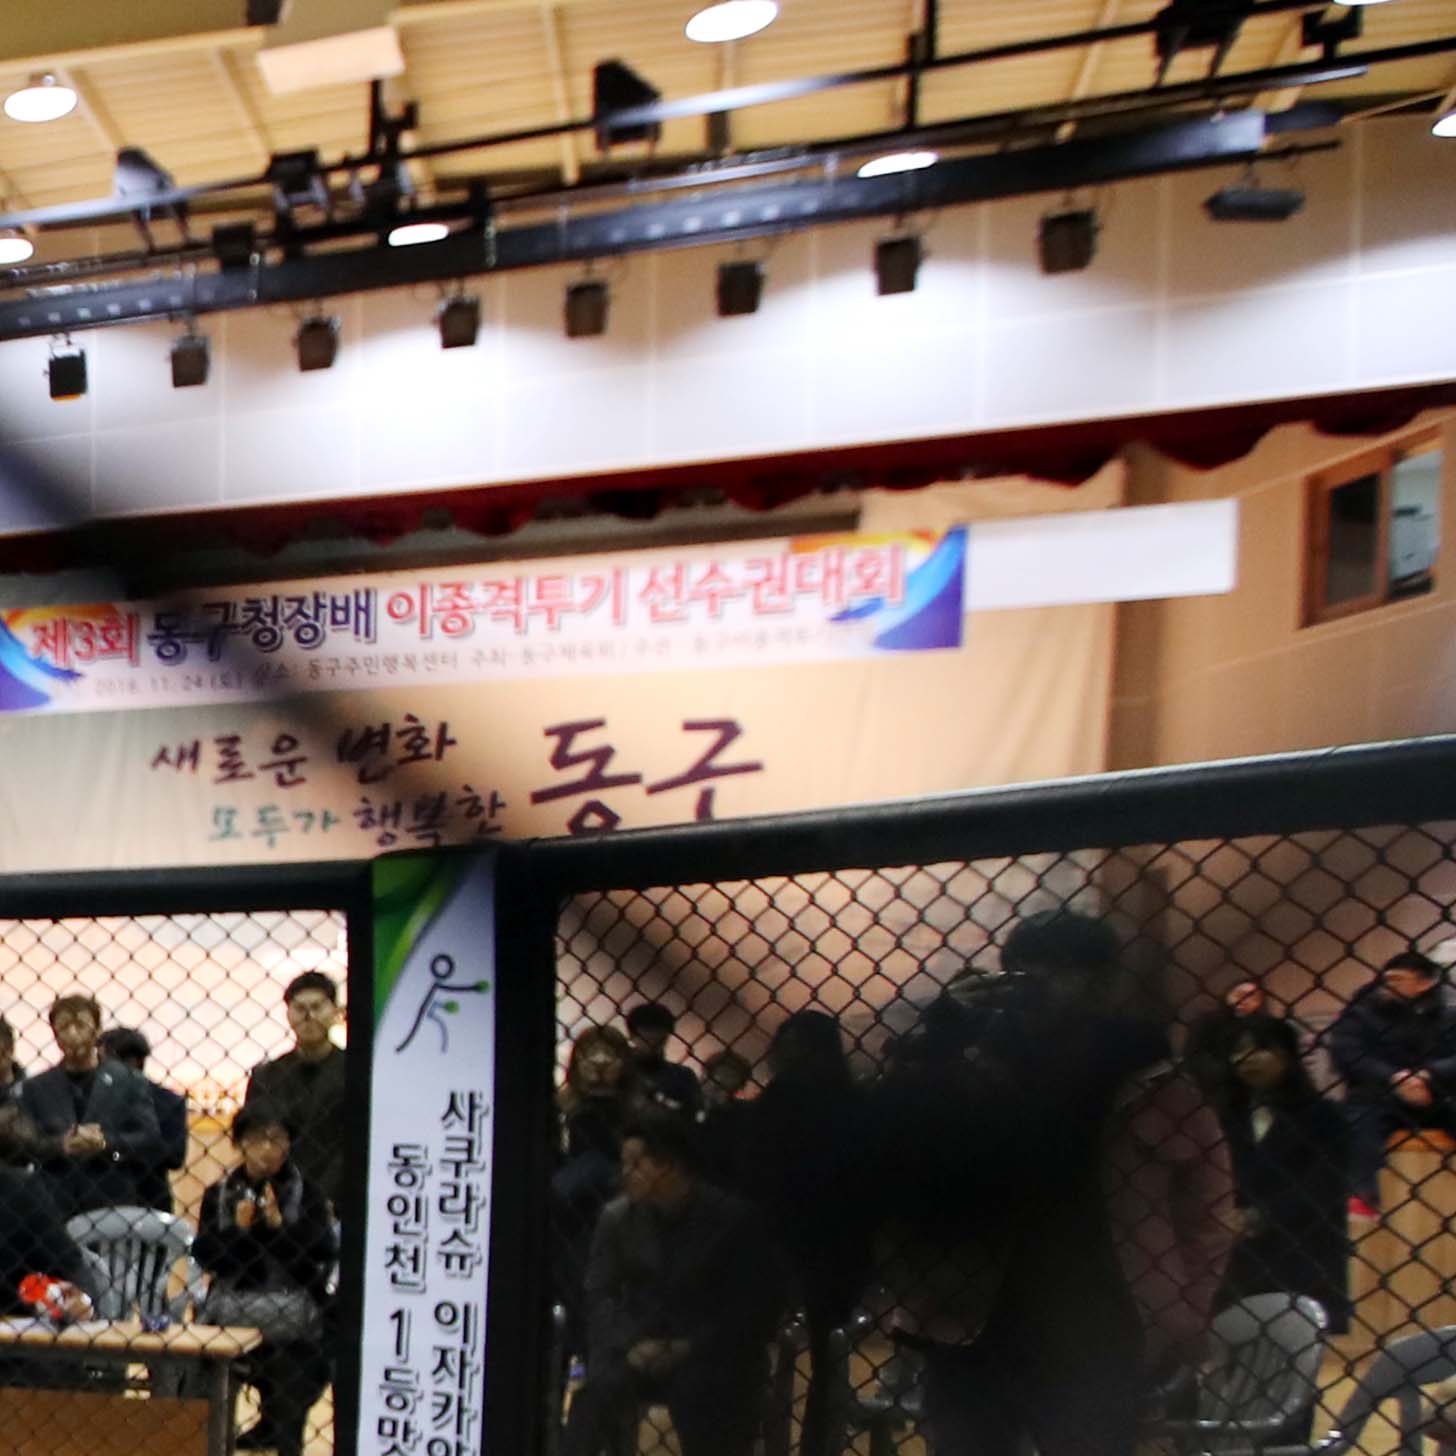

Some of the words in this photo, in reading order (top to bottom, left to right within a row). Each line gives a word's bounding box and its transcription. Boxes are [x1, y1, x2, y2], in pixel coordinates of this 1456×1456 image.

[30, 612, 142, 668] 제3회
[148, 586, 378, 666] 동구청장배
[385, 570, 626, 638] 이종격투기
[638, 544, 908, 623] 선수권대회
[151, 733, 308, 788] 새로운
[336, 713, 456, 788] 변화
[530, 717, 764, 839] 동구
[207, 803, 341, 850] 모두가
[352, 782, 506, 846] 행복한
[384, 1143, 430, 1290] 동인천
[437, 1090, 485, 1275] 사쿠라슈
